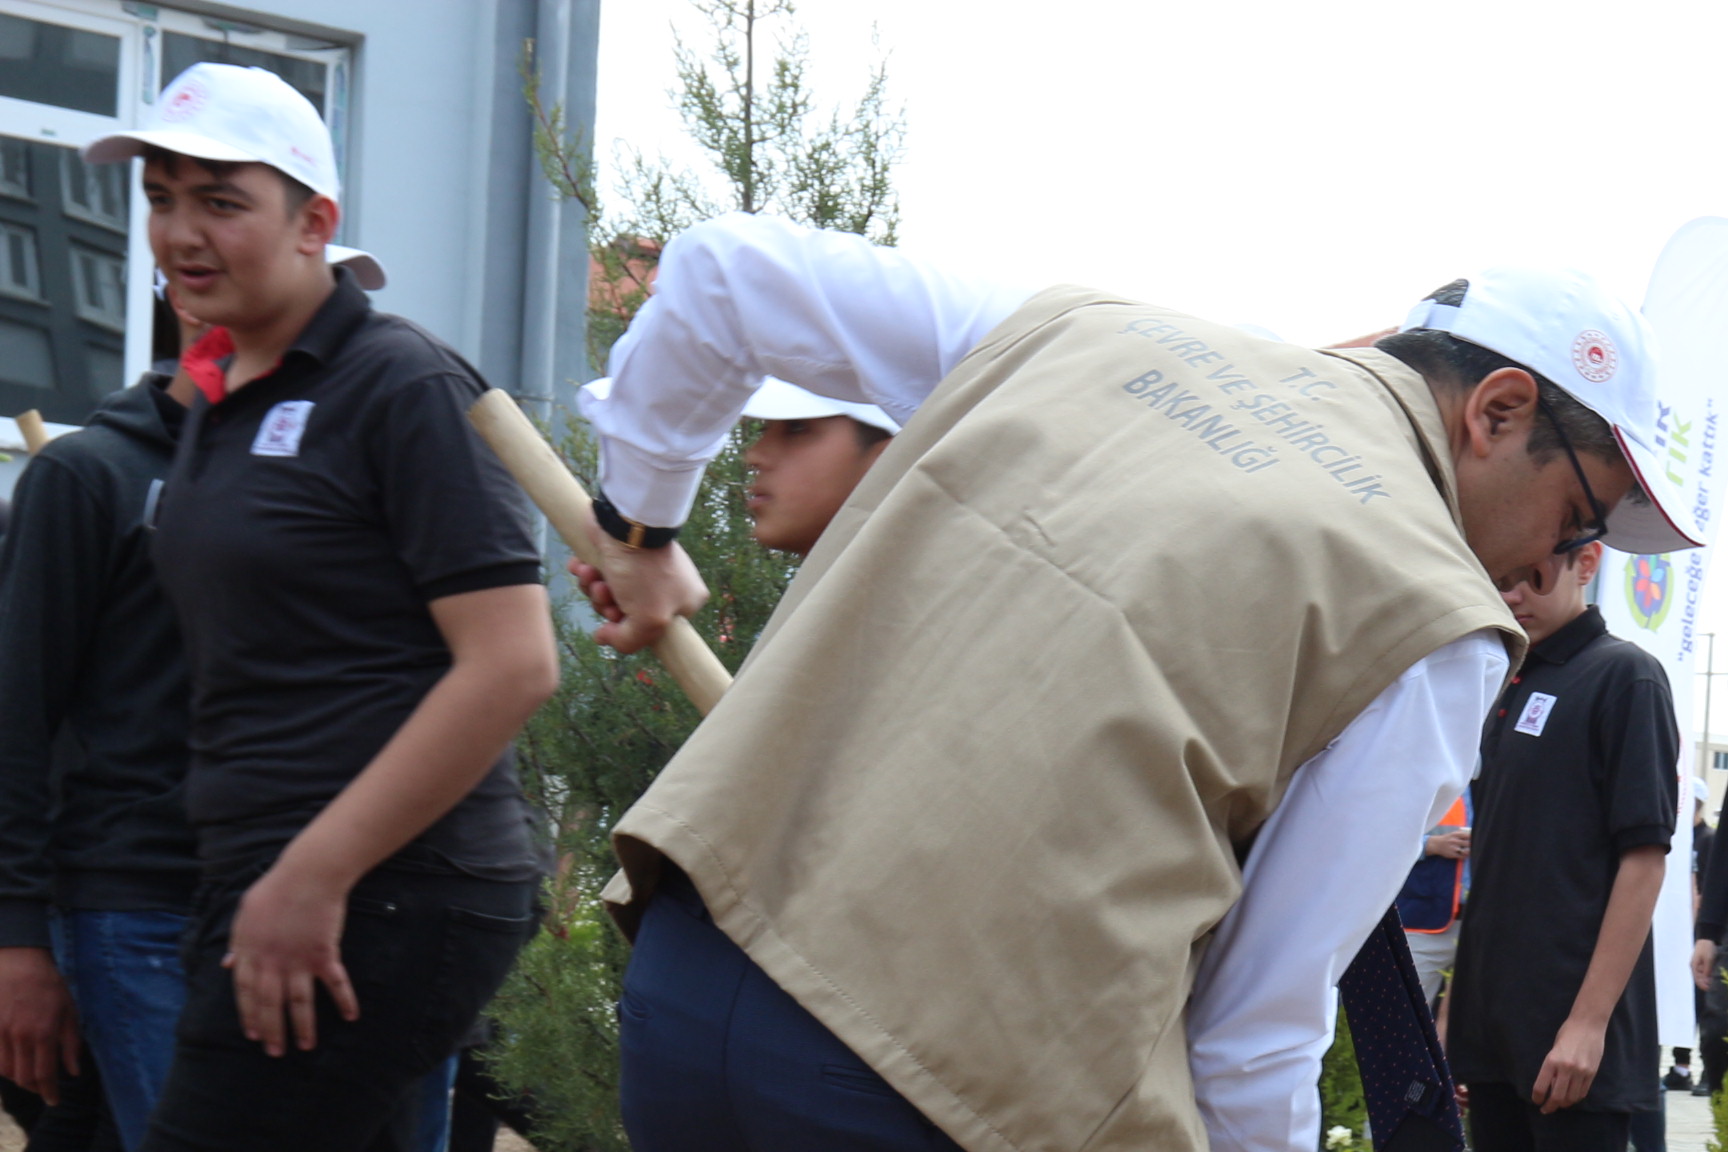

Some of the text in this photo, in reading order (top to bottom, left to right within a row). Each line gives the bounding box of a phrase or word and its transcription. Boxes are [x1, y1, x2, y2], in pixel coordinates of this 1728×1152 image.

[1118, 318, 1391, 505] ÇEVRE VE ŞEHİRCİLİK
[1122, 368, 1281, 474] BAKANLIĞI
[1280, 366, 1337, 402] T.C.
